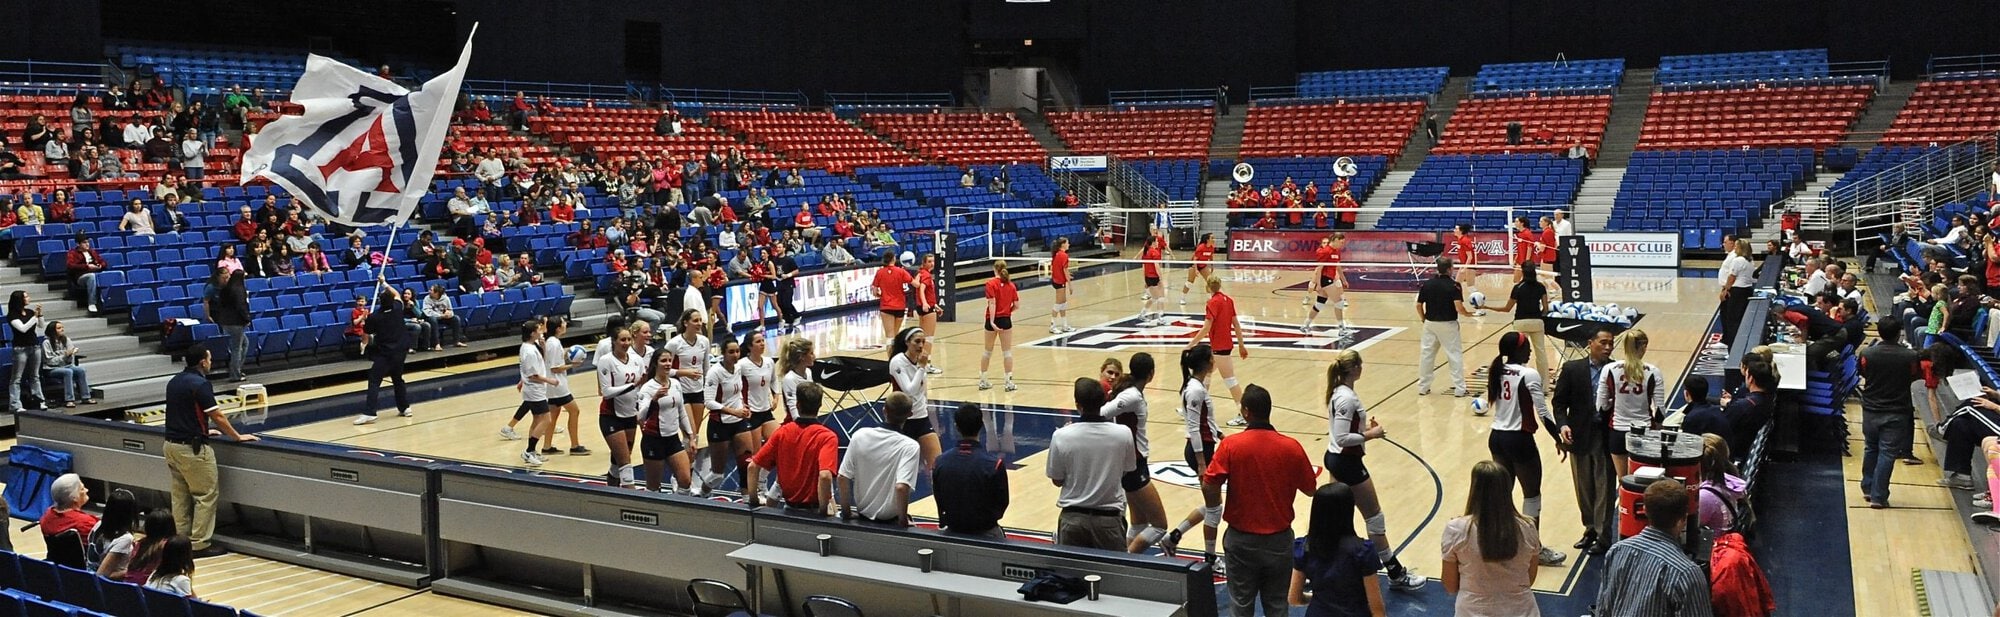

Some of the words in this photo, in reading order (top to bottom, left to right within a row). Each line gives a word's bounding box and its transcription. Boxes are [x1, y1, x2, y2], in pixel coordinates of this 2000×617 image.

[1233, 239, 1280, 253] BEAR
[1588, 242, 1673, 253] ILDCATCLUB
[938, 241, 947, 306] ARIZONA
[624, 372, 636, 385] 22
